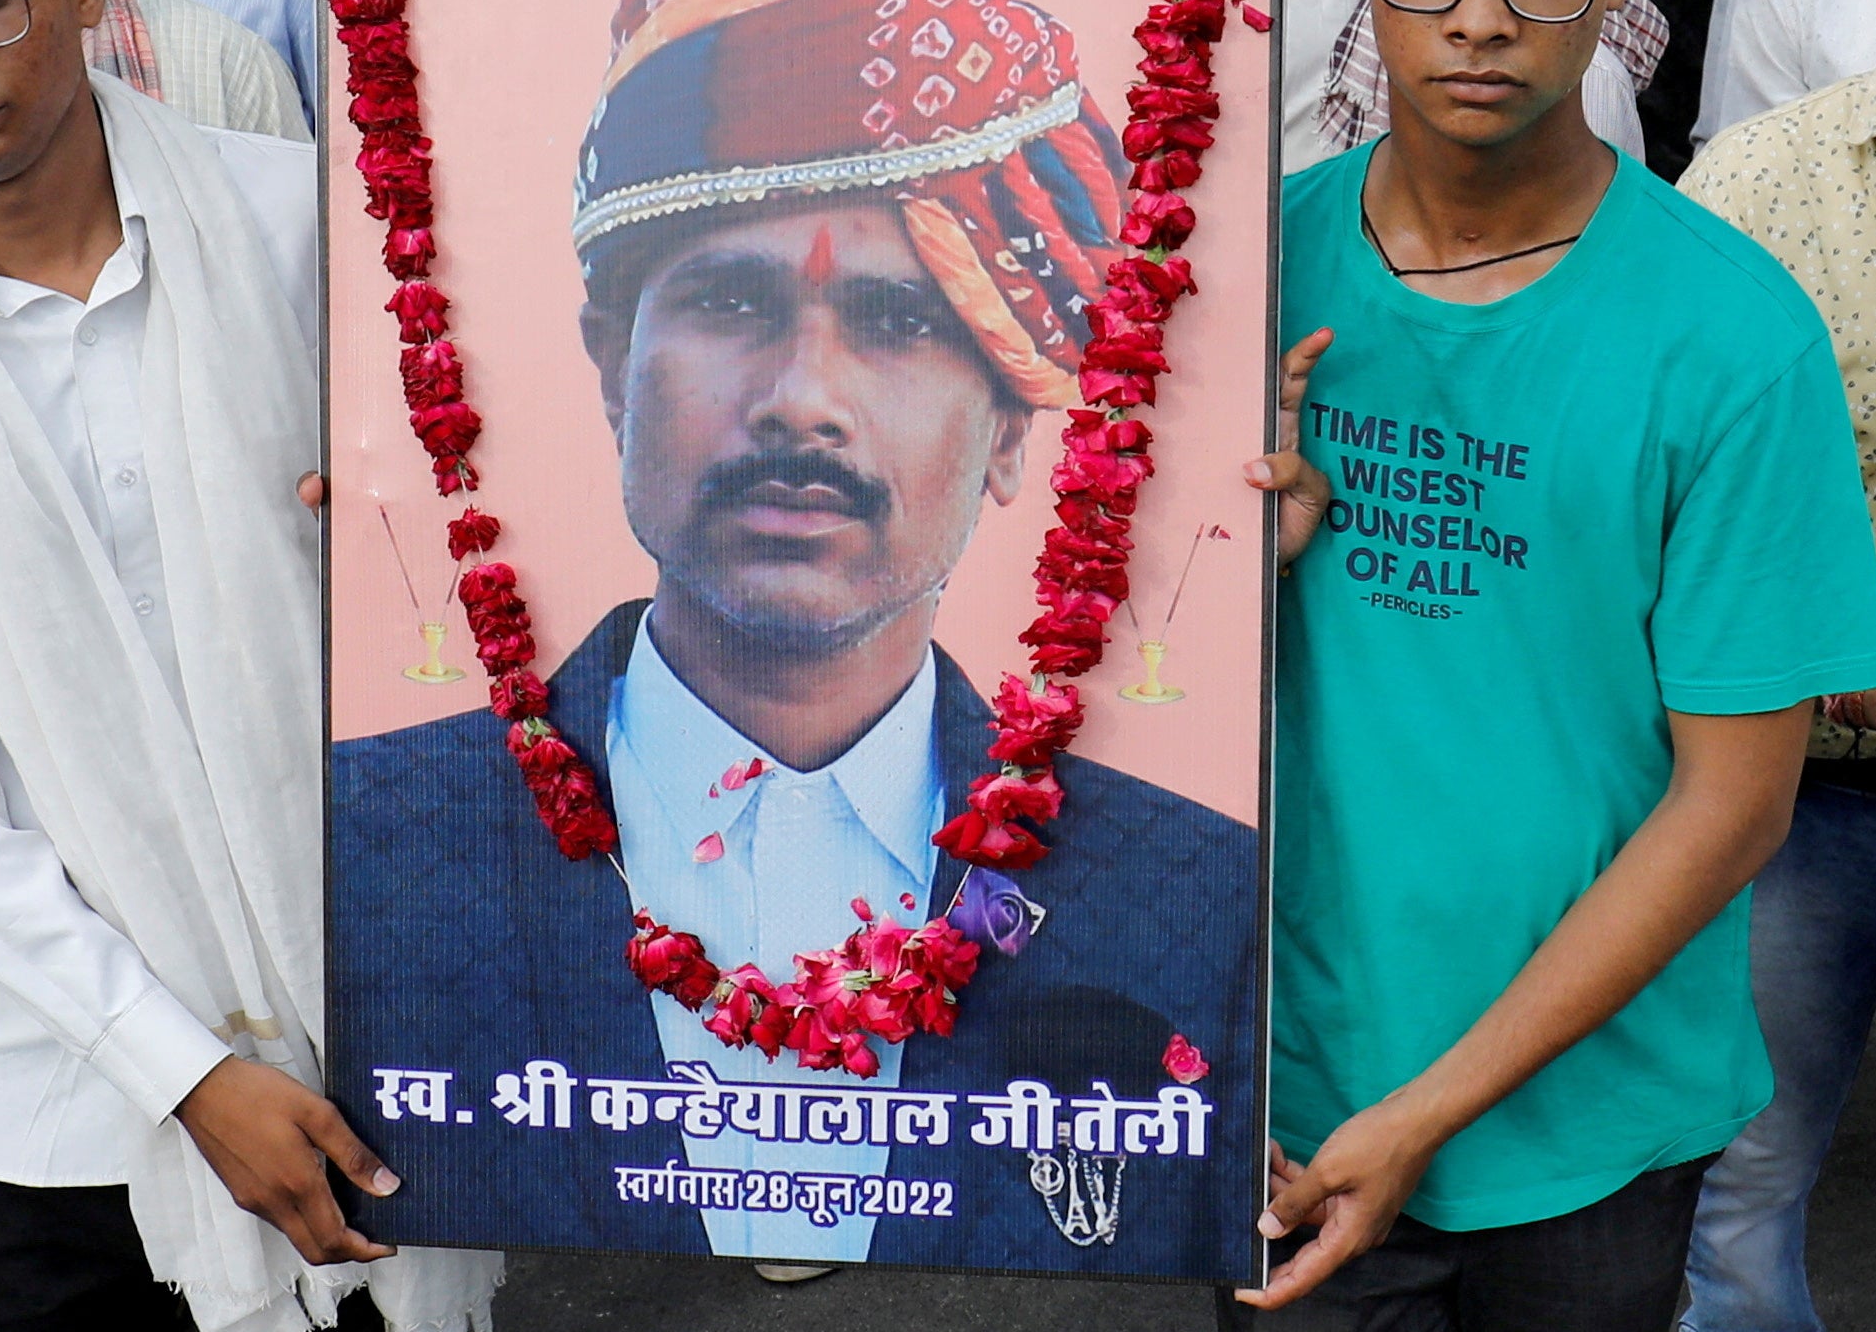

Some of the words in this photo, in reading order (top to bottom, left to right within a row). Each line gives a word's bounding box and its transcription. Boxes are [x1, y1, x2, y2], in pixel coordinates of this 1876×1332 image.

[1309, 402, 1398, 455] TIME
[1408, 424, 1446, 460] IS
[1456, 432, 1531, 480] THE
[1340, 455, 1486, 511] WISEST
[1321, 498, 1529, 570] OUNSELOR
[1346, 548, 1399, 585] OF
[1407, 560, 1480, 596] ALL
[491, 1061, 578, 1128] श्री
[587, 1064, 957, 1145] कन्हैयालाल
[967, 1080, 1062, 1150] जी
[1069, 1081, 1213, 1156] तेली
[614, 1160, 739, 1207] स्वर्गवास
[746, 1175, 788, 1209] 28
[796, 1176, 857, 1224] जून
[863, 1179, 953, 1216] 2022
